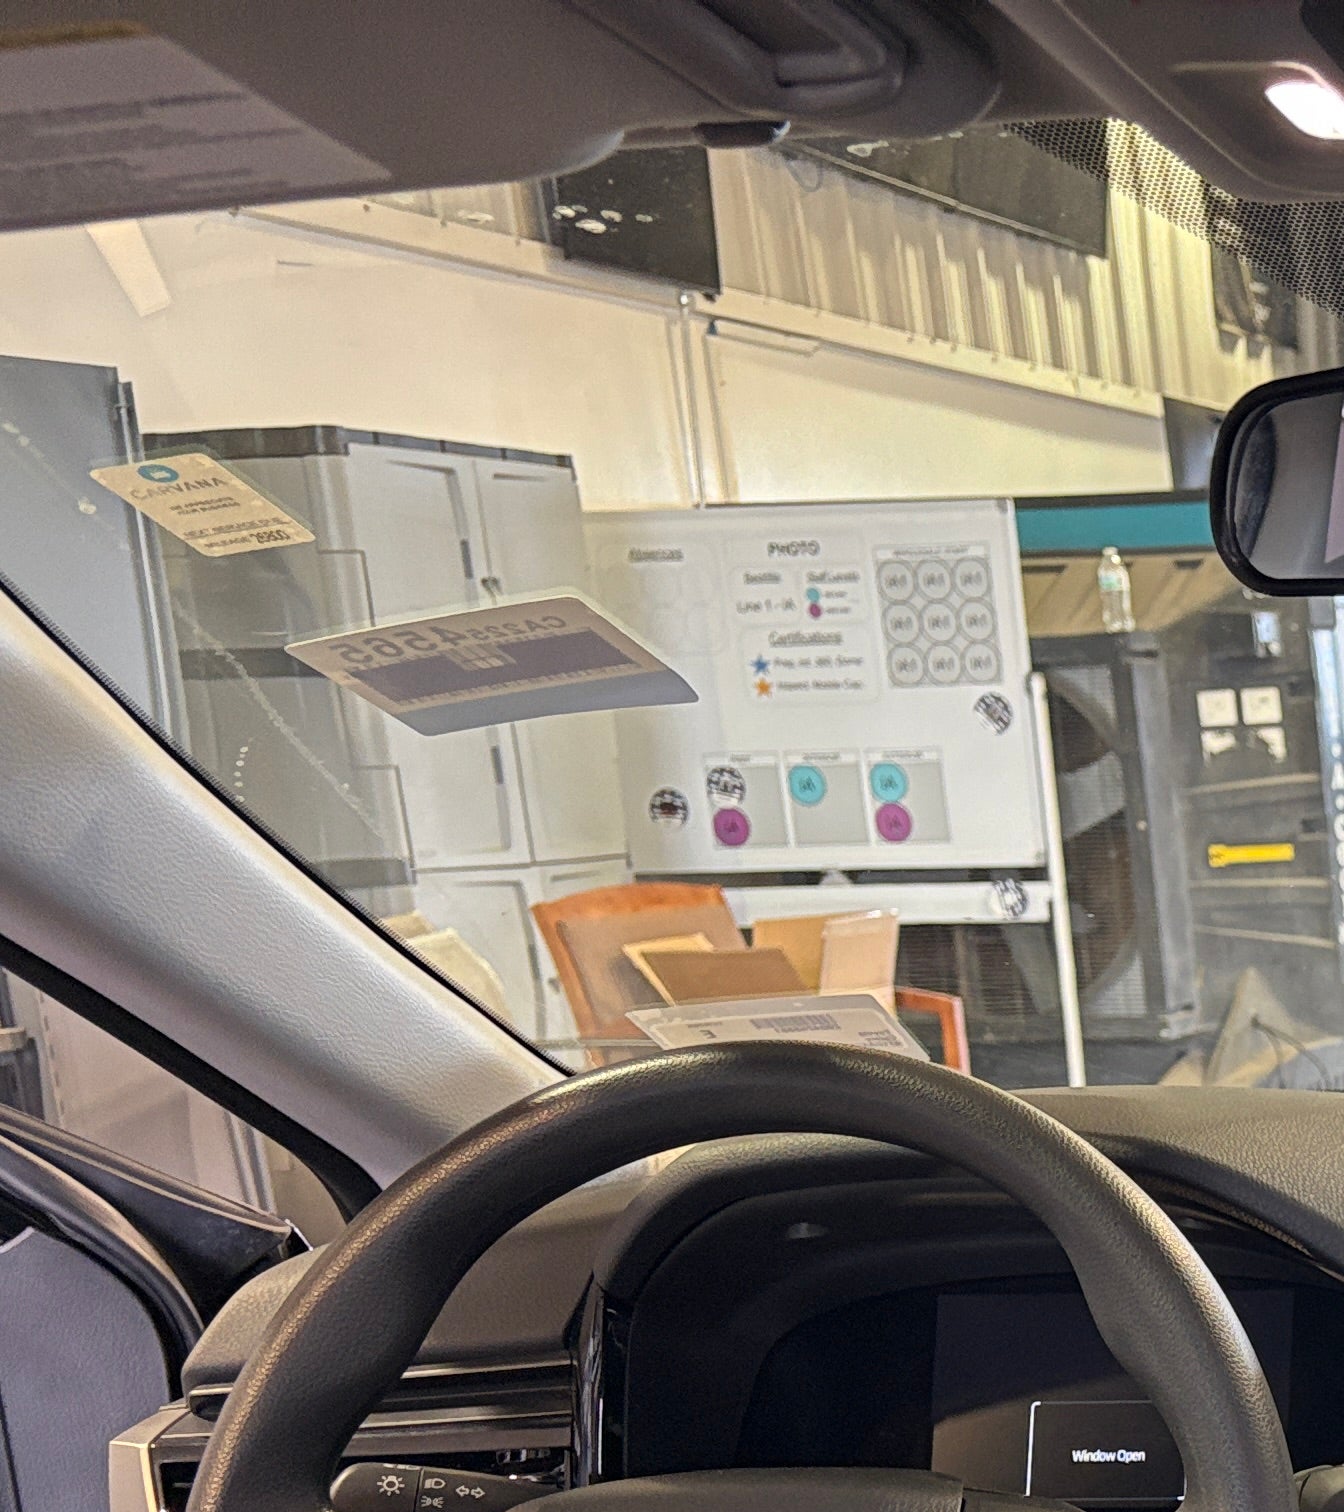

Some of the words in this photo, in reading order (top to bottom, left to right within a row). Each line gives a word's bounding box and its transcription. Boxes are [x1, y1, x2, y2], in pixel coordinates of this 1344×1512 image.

[130, 477, 226, 501] CARVANA
[767, 541, 820, 557] PHOTO
[1072, 1449, 1116, 1462] Window
[1117, 1449, 1146, 1464] Open
